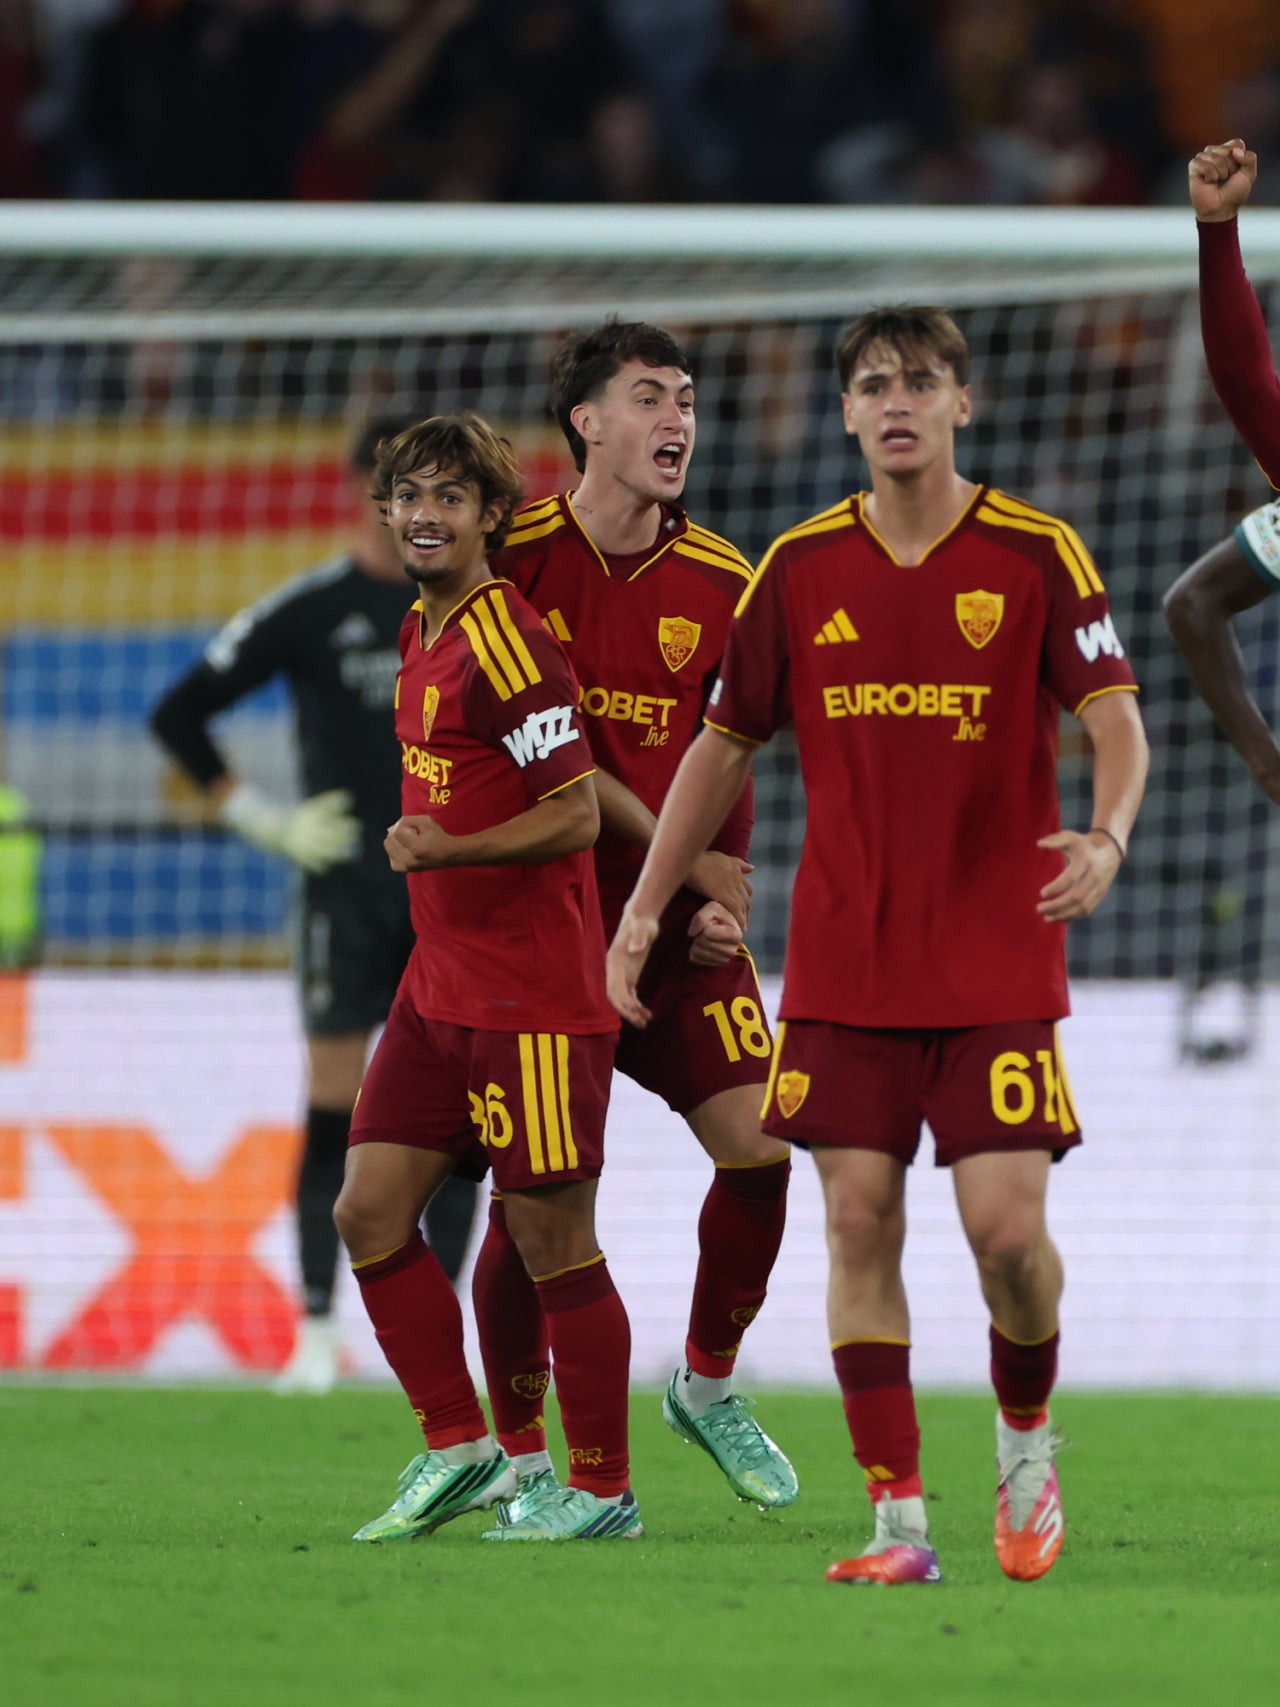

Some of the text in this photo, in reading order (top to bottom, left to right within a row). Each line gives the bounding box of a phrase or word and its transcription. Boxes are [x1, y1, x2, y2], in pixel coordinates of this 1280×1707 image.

[823, 683, 991, 718] EUROBET
[703, 996, 771, 1063] 18
[990, 1050, 1059, 1125] 61
